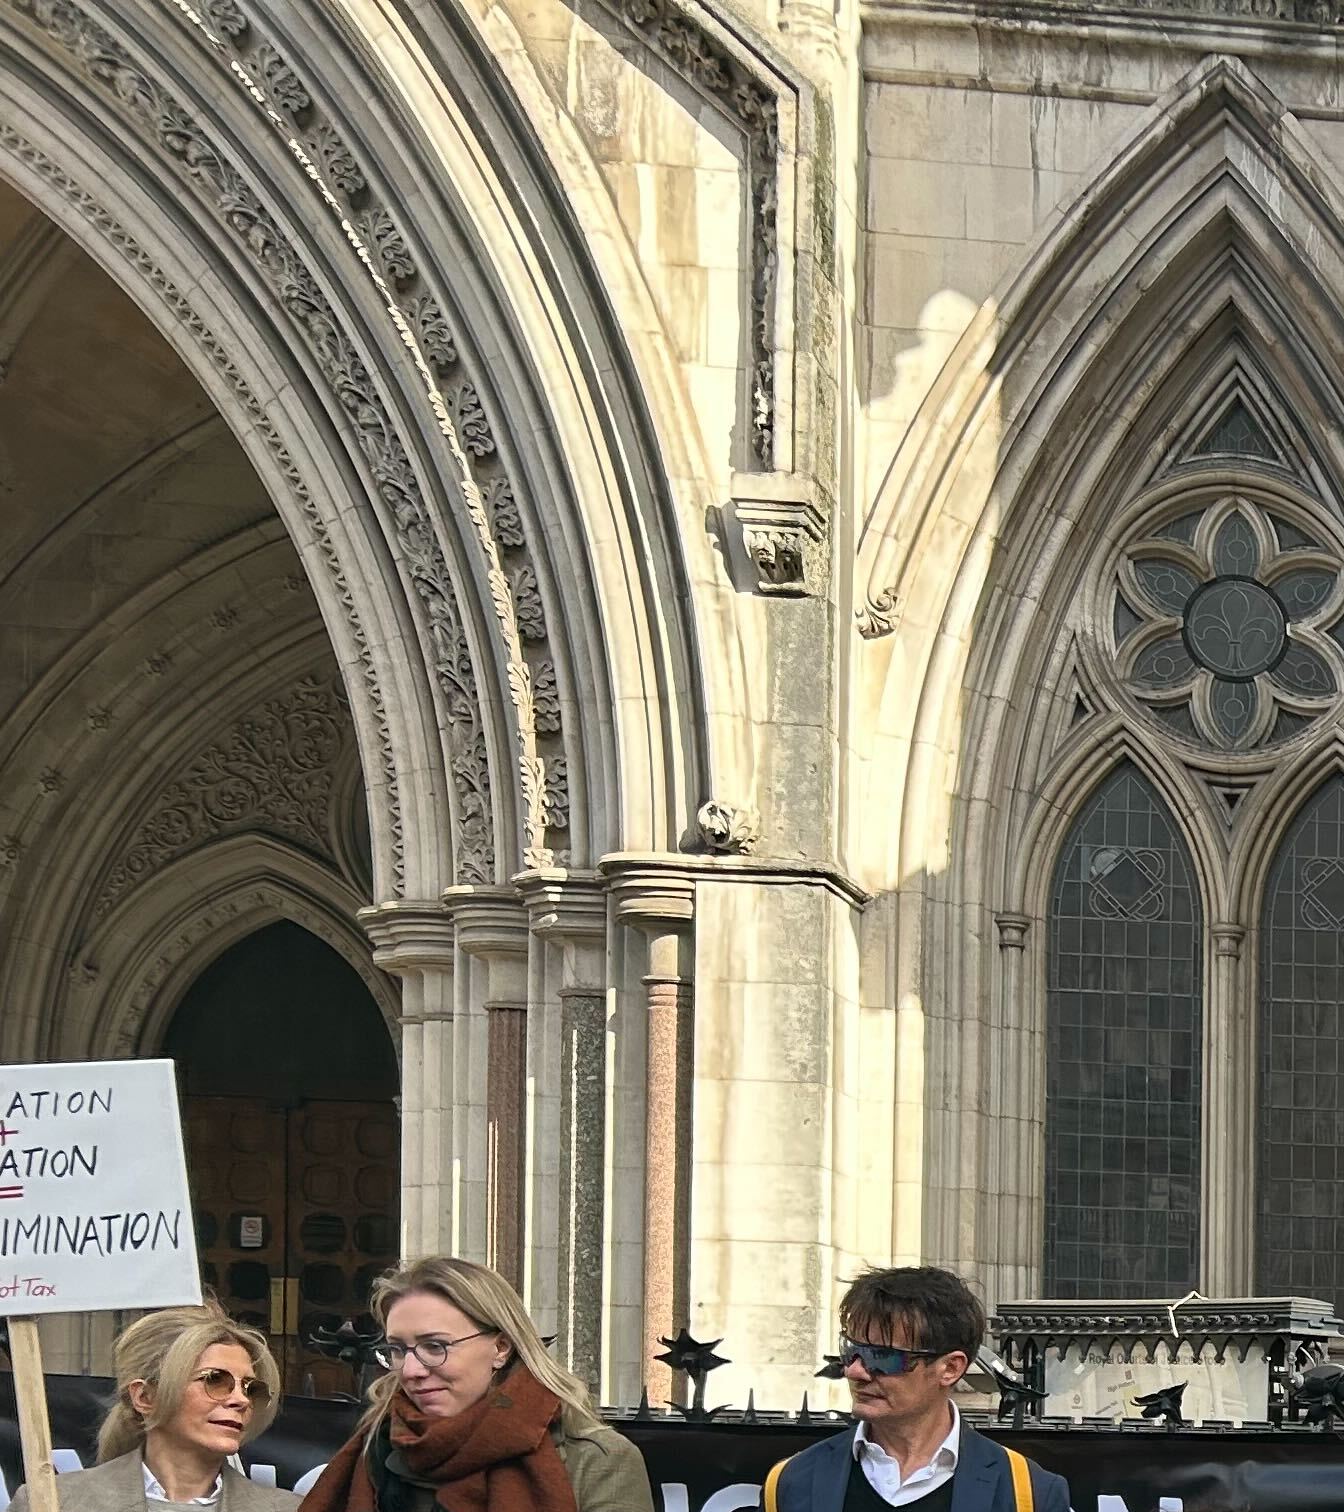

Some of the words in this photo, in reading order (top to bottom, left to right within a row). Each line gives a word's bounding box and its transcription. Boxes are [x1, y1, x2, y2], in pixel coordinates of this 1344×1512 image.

[6, 1088, 112, 1119] ATION
[0, 1145, 98, 1178] ATION
[0, 1209, 181, 1257] IMINATION
